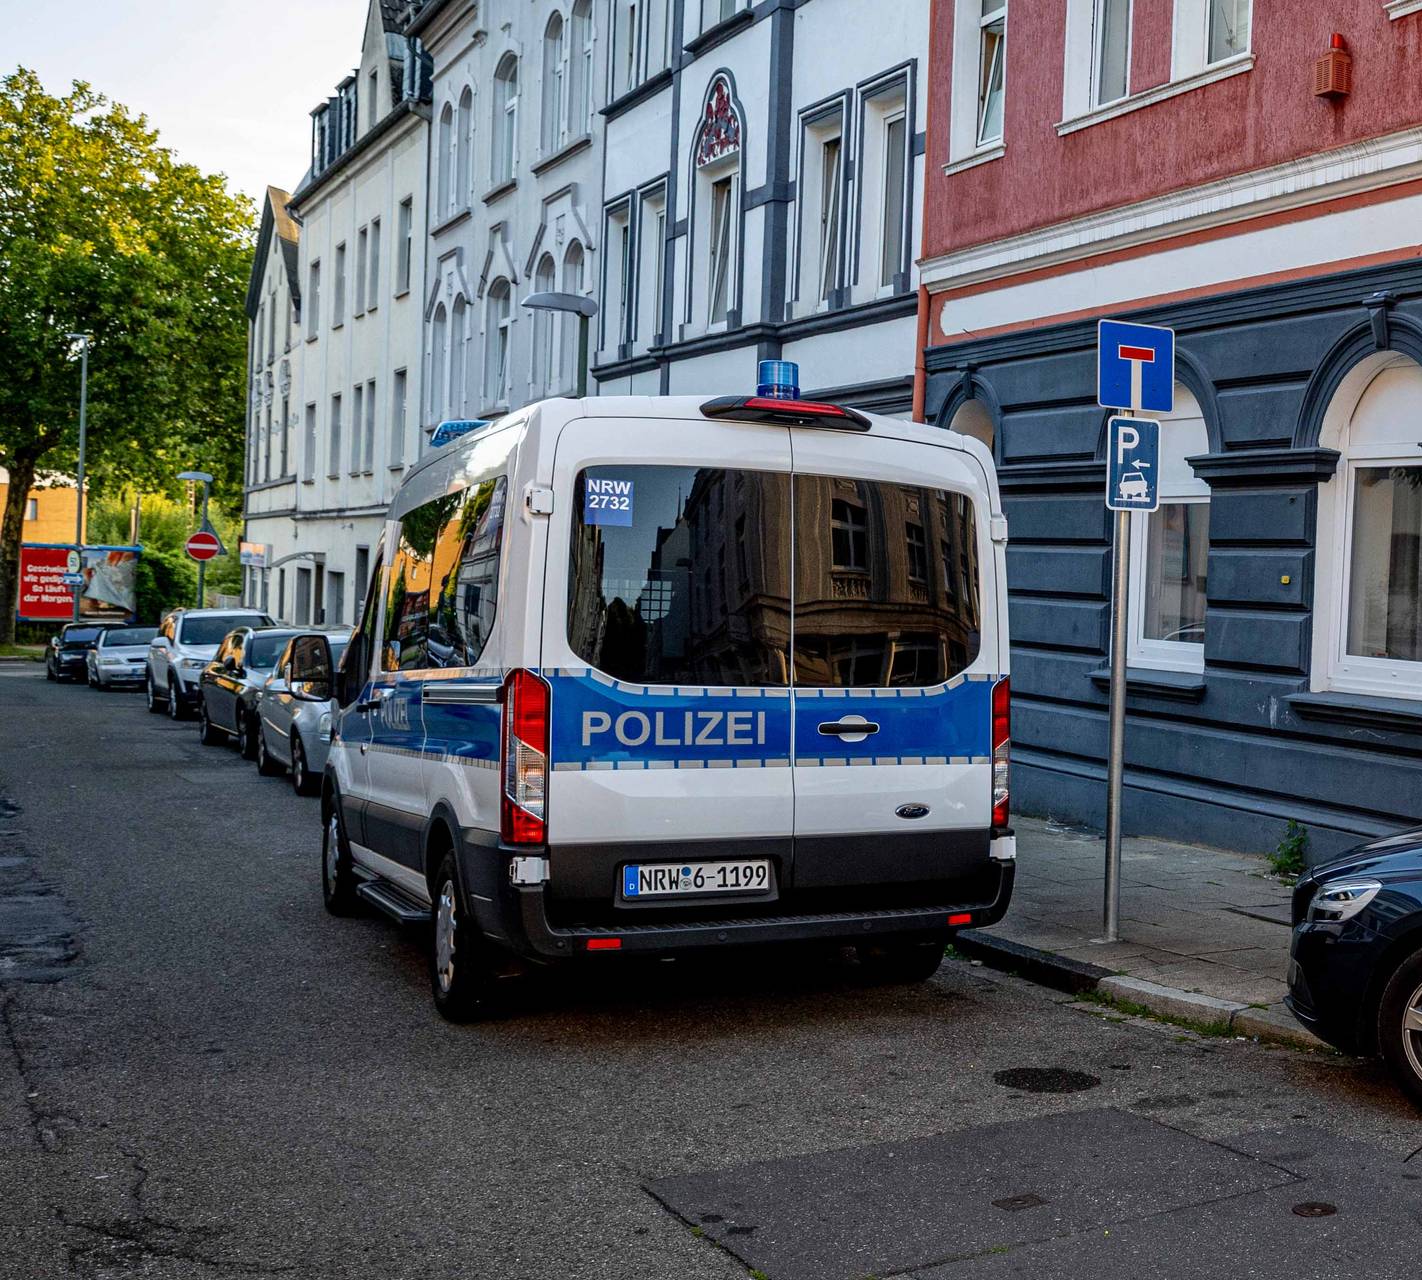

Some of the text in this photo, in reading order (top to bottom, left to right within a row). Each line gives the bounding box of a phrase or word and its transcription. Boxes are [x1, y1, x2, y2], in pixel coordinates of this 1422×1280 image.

[1118, 426, 1140, 464] P
[588, 480, 631, 494] NRW
[589, 495, 629, 510] 2732
[581, 711, 765, 746] POLIZEI
[640, 869, 680, 891] NRW
[693, 865, 767, 888] 6-1199
